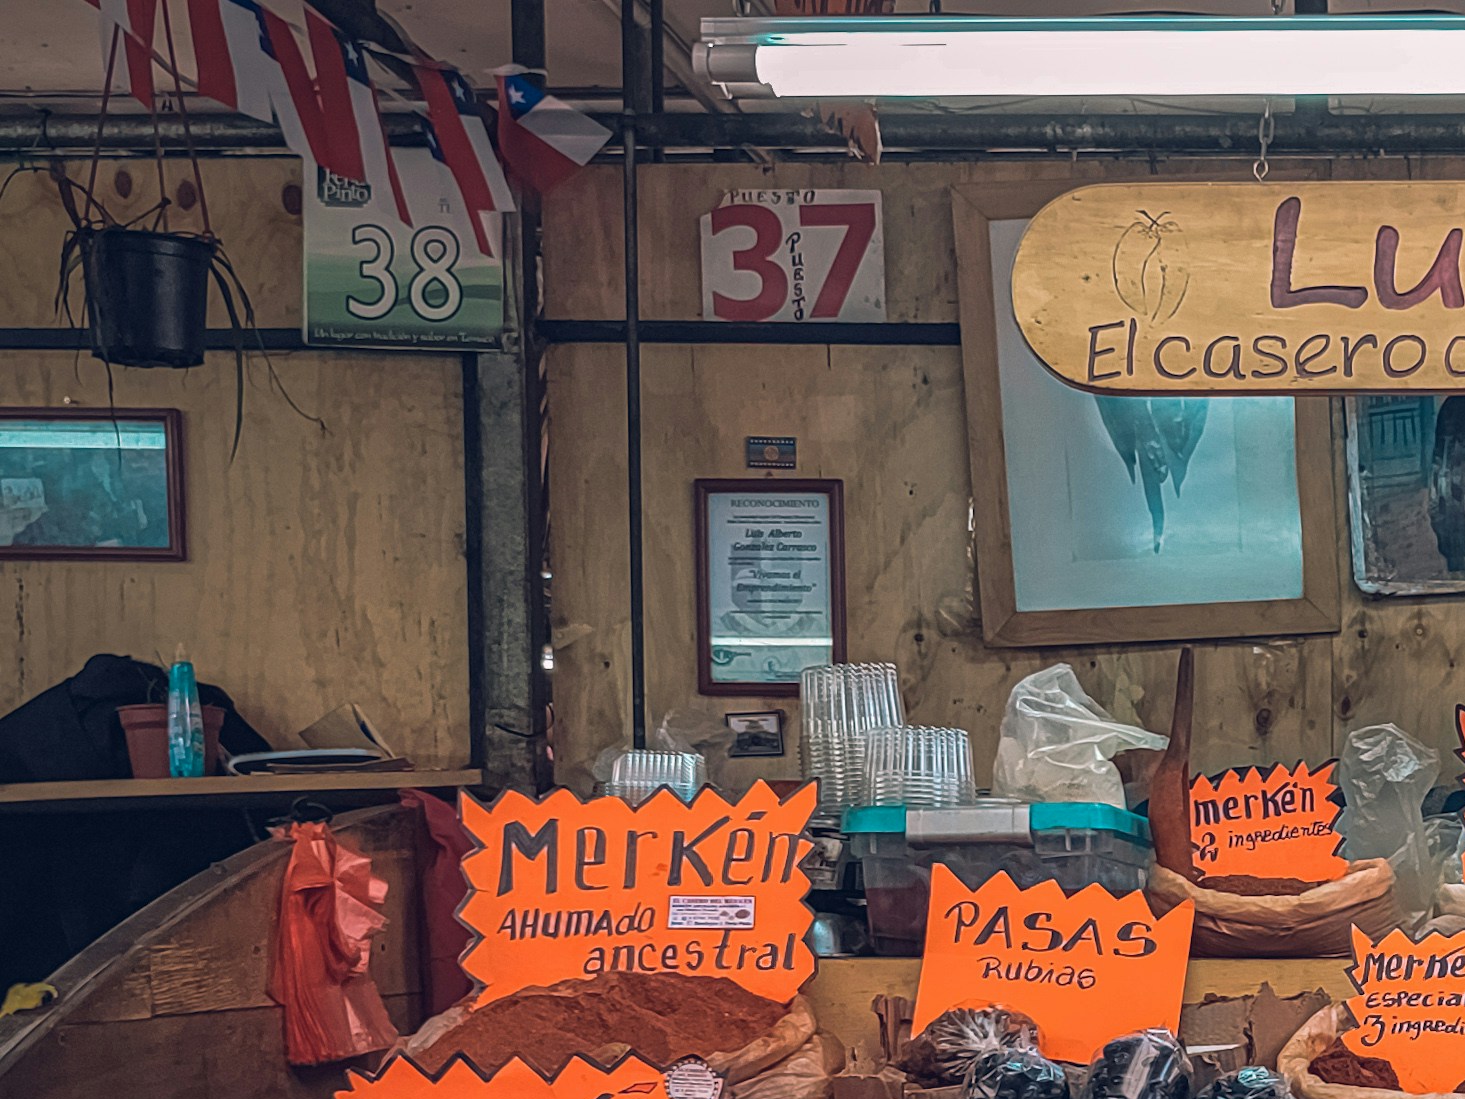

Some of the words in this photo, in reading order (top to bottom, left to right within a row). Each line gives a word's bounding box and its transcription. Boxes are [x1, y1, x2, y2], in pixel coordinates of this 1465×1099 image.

[324, 183, 369, 202] Pinto
[728, 190, 816, 205] PUESTO
[346, 224, 463, 322] 38
[711, 203, 876, 322] 37
[785, 232, 806, 321] PUESTO
[1085, 317, 1137, 382] El
[1152, 330, 1428, 382] casero
[731, 499, 820, 508] RECONOCIMIENTO
[768, 529, 802, 538] Alberto
[944, 900, 1157, 957] PASAS
[582, 929, 796, 975] ancestral
[977, 956, 1096, 989] Rubias
[1361, 1014, 1386, 1046] 3
